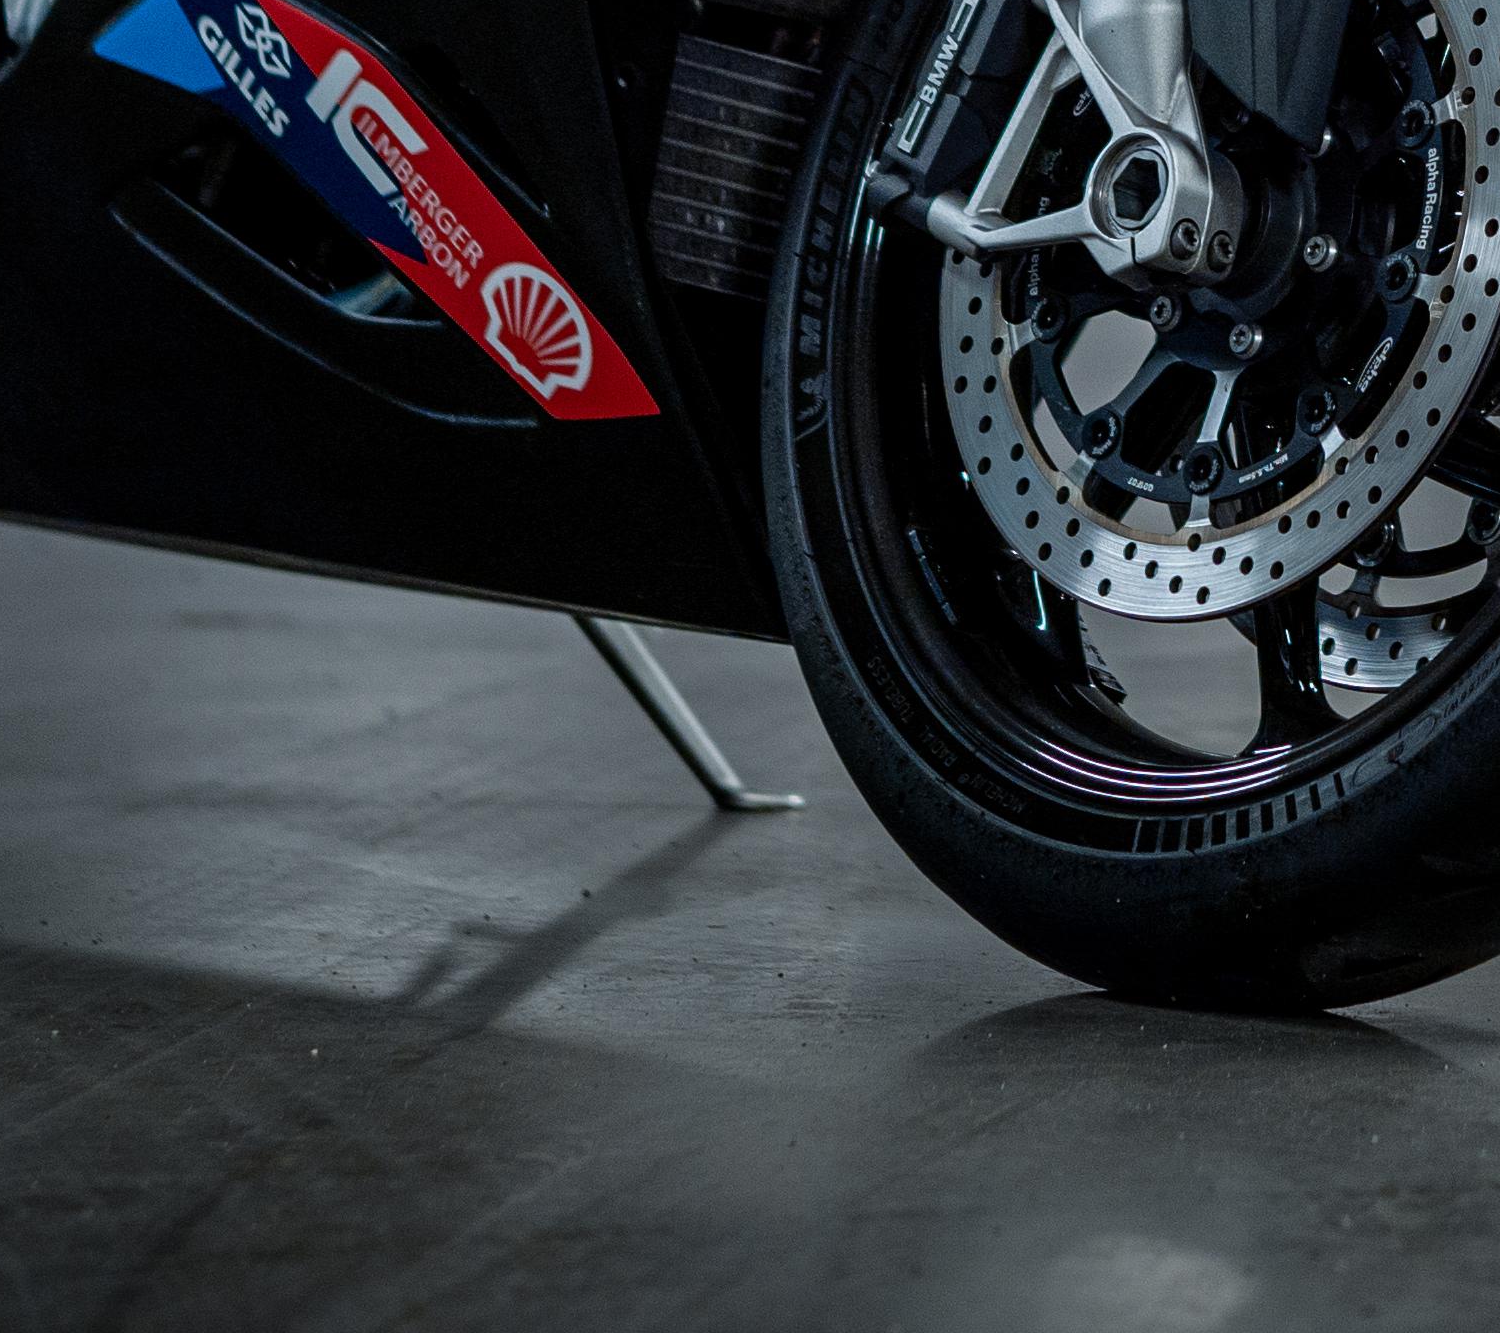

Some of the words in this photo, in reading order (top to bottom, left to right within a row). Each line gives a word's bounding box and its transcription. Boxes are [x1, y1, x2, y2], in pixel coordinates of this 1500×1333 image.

[198, 14, 291, 137] GILLES
[920, 35, 960, 105] BMW
[799, 83, 874, 358] MICHELIN
